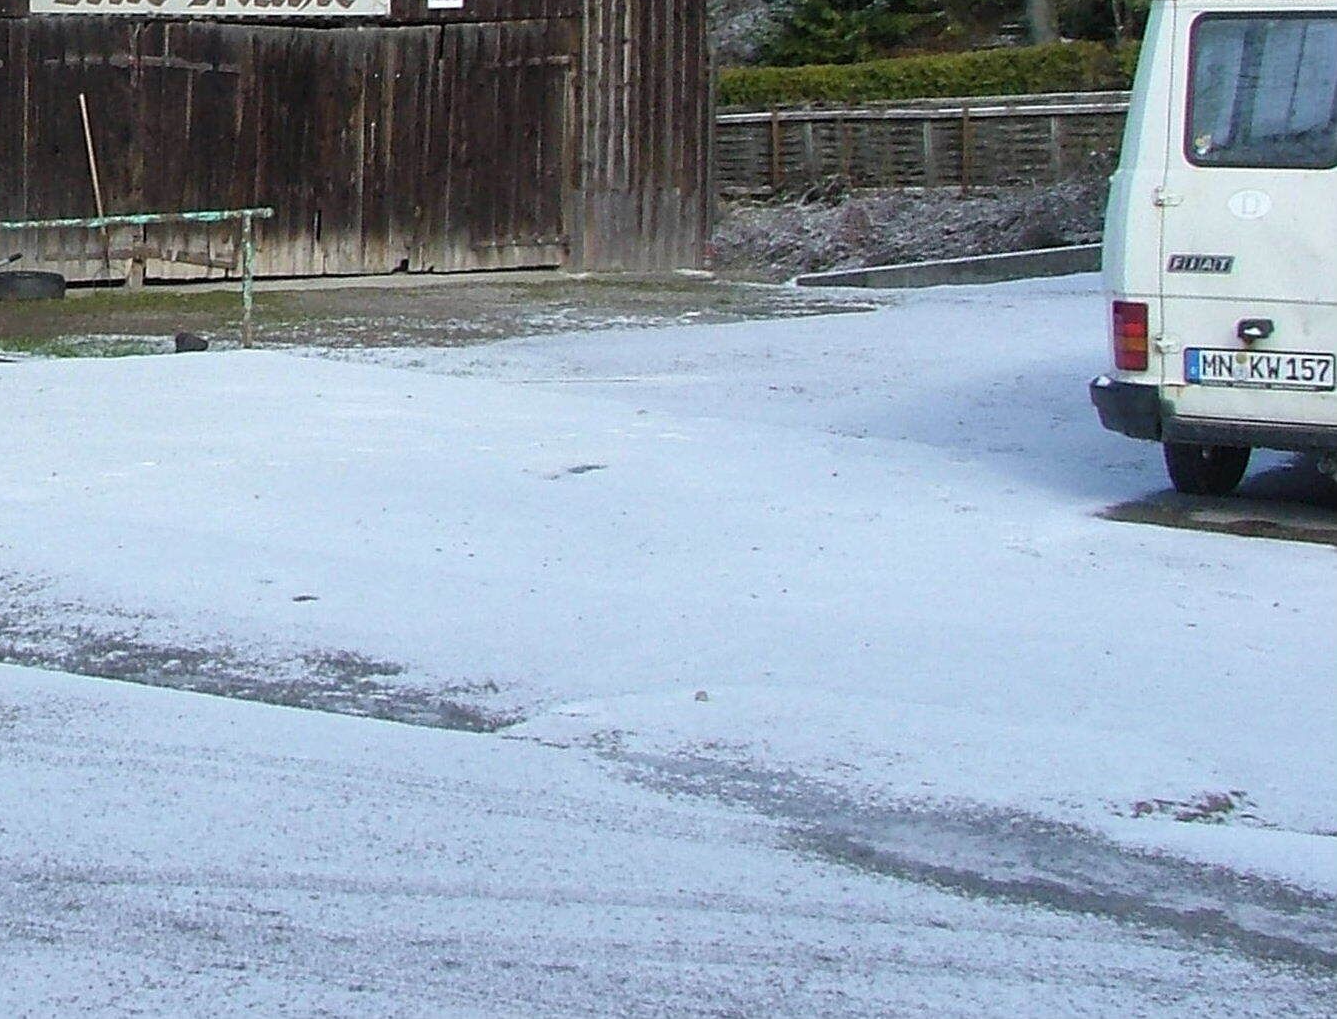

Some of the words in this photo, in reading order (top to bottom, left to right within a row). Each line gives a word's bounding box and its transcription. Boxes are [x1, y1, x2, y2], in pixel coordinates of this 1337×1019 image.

[1170, 255, 1232, 272] FIAT
[1202, 354, 1233, 377] MN
[1250, 356, 1281, 380] KW
[1286, 358, 1331, 383] 157
